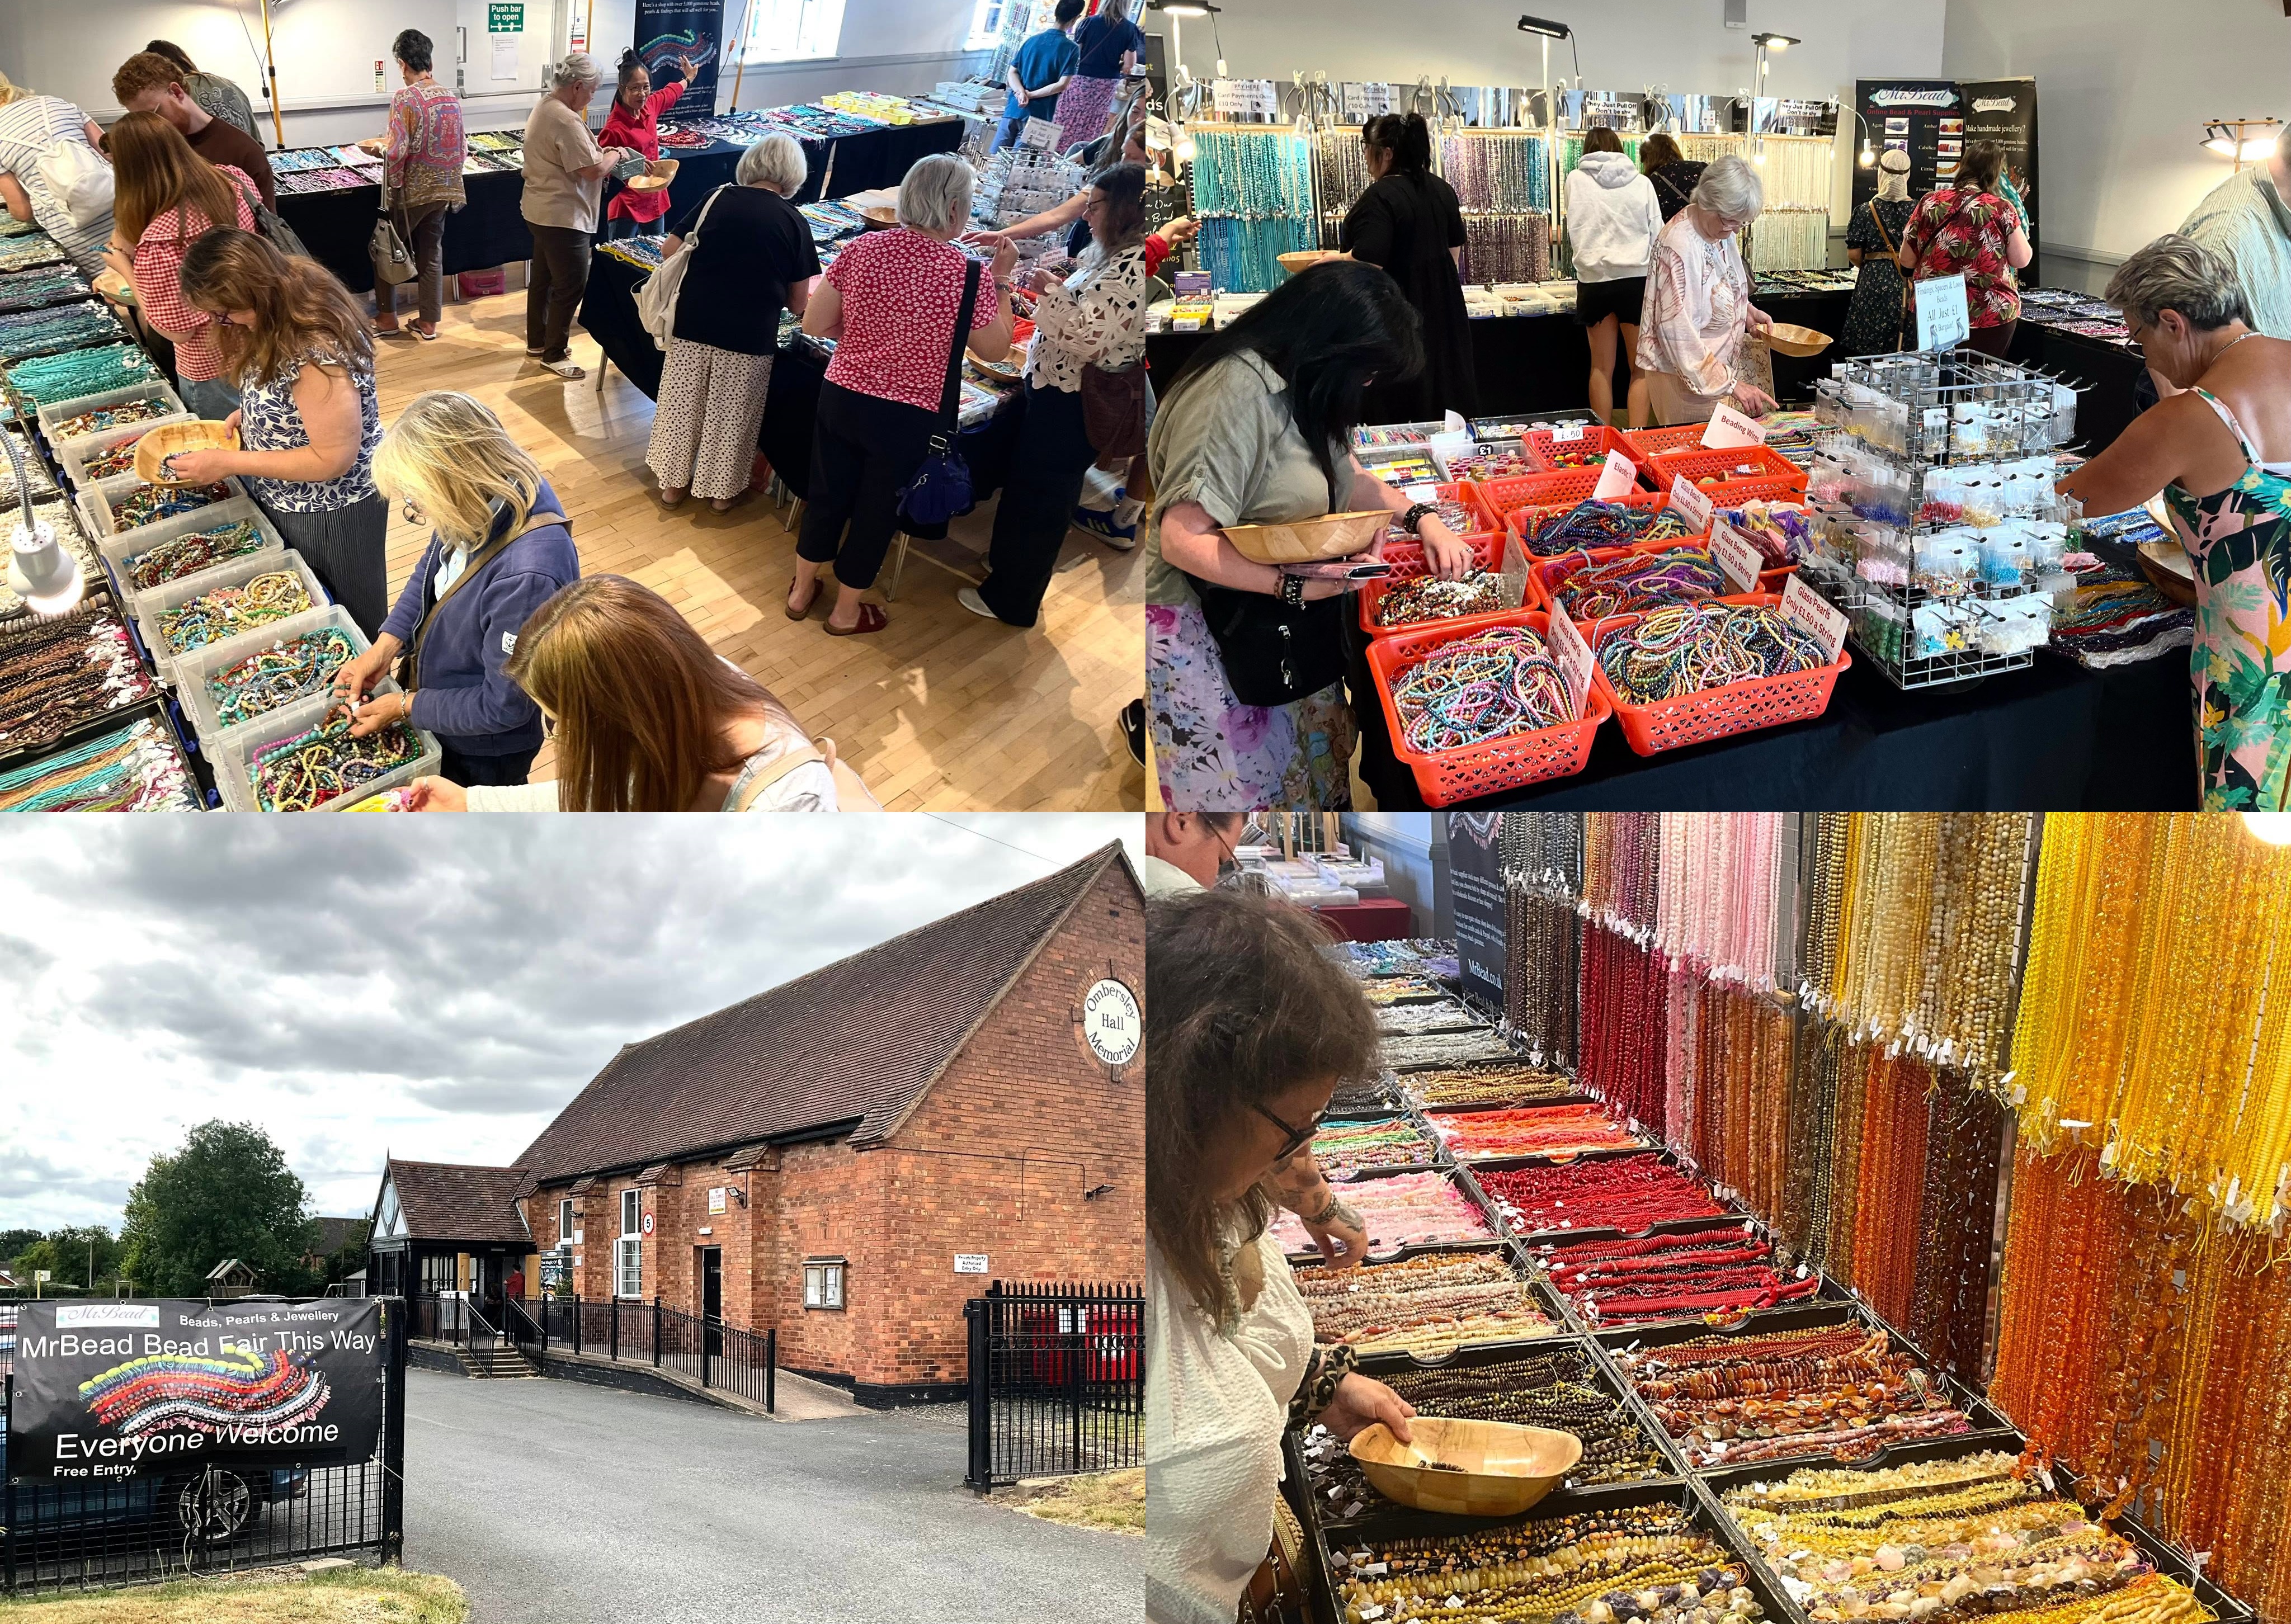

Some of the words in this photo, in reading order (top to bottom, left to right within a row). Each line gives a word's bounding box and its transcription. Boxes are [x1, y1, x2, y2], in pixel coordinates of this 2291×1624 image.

[1146, 98, 1163, 111] ds
[2001, 124, 2026, 134] jewellery?
[1154, 199, 1173, 210] Our
[1152, 210, 1174, 223] Bad
[1917, 286, 1935, 296] Findings,
[1935, 284, 1949, 294] Spacers
[1937, 294, 1948, 303] Beads
[1927, 309, 1936, 322] All
[1939, 306, 1949, 319] Just
[1951, 304, 1958, 316] £1
[1938, 320, 1954, 332] Bargain!
[1720, 415, 1746, 435] Beading
[1747, 427, 1760, 443] Wires
[1479, 446, 1492, 455] £1
[1614, 462, 1628, 478] Elastic
[1681, 481, 1690, 493] Glass
[1690, 488, 1701, 503] Beads
[1680, 496, 1690, 509] £1.50
[1693, 507, 1704, 523] String
[1722, 531, 1733, 546] Glass
[1733, 541, 1747, 559] Beads
[1712, 539, 1722, 554] Only
[1722, 547, 1734, 565] £1.50
[1738, 563, 1752, 583] String
[1798, 587, 1813, 605] Glass
[1812, 598, 1831, 620] Pearls
[1786, 595, 1799, 613] Only
[1798, 606, 1814, 625] £1.50
[1818, 624, 1837, 648] String
[1559, 617, 1569, 639] Glass
[1569, 632, 1581, 658] Pearls
[1551, 626, 1559, 646] Only
[1559, 639, 1570, 660] £1.50
[1572, 660, 1585, 688] String
[1468, 958, 1503, 990] MrBead.co.uk
[1087, 983, 1135, 1019] Ombersley
[1102, 1013, 1124, 1031] Hall
[1088, 1031, 1135, 1061] Memorial
[646, 1219, 650, 1228] 5
[180, 1315, 222, 1328] Beads,
[226, 1313, 267, 1326] Pearls
[270, 1312, 280, 1322] &
[284, 1311, 339, 1323] Jewellery
[22, 1333, 133, 1358] MrBead
[144, 1334, 208, 1357] Bead
[219, 1335, 268, 1355] Fair
[274, 1330, 324, 1351] This
[330, 1330, 376, 1354] Way
[56, 1433, 204, 1461] Everyone
[215, 1422, 339, 1444] Welcome
[54, 1466, 88, 1477] Free
[93, 1464, 137, 1476] Entry,
